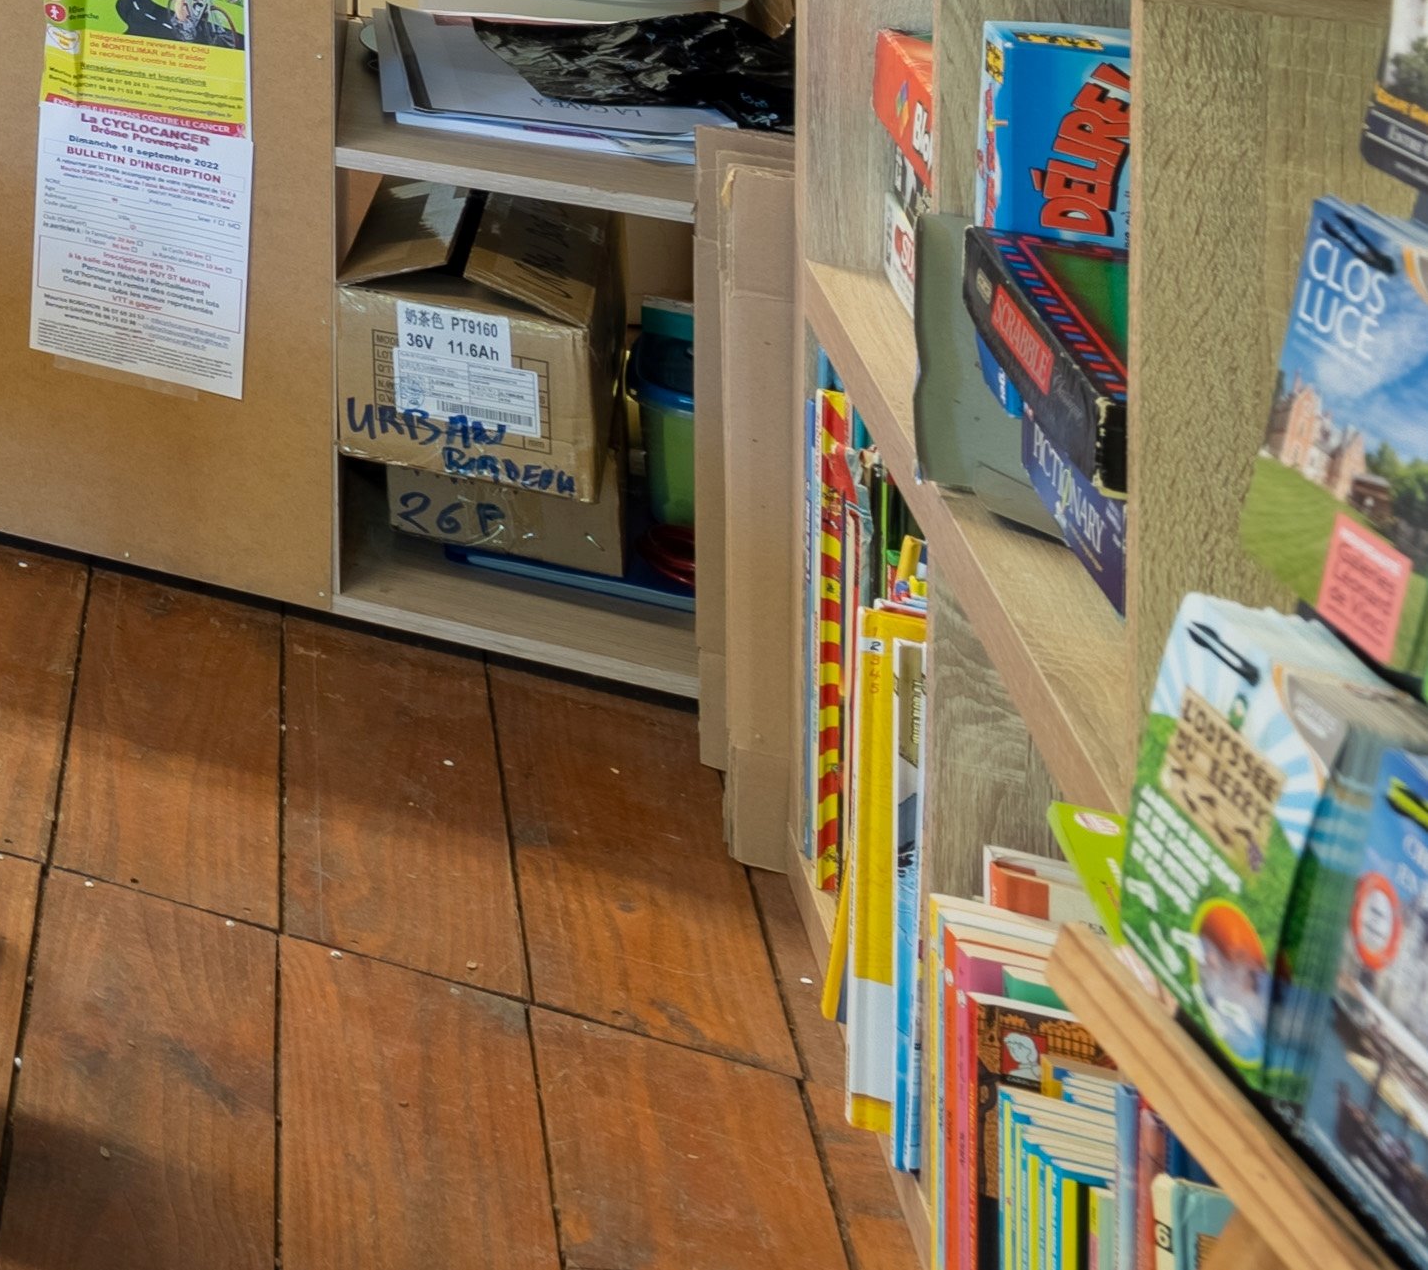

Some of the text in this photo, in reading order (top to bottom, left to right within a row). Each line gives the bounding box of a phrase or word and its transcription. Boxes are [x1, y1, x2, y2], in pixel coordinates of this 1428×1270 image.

[80, 113, 211, 146] La CYCLOCANCER
[91, 124, 199, 153] Drôme Provençale
[142, 112, 229, 134] CONTRE LE CANCER
[67, 145, 126, 165] BULLETIN
[130, 156, 222, 184] D'INSCRIPTION
[68, 134, 220, 171] Dimanche 18 septembre 2022
[180, 274, 212, 290] MARTIN
[1307, 238, 1388, 319] CLOS
[404, 307, 444, 330] 奶茶色
[451, 316, 498, 338] PT9160
[406, 332, 499, 361] 36V 11.6Ah
[992, 285, 1054, 392] SCRABBLE
[1032, 426, 1108, 555] PICTIONARY
